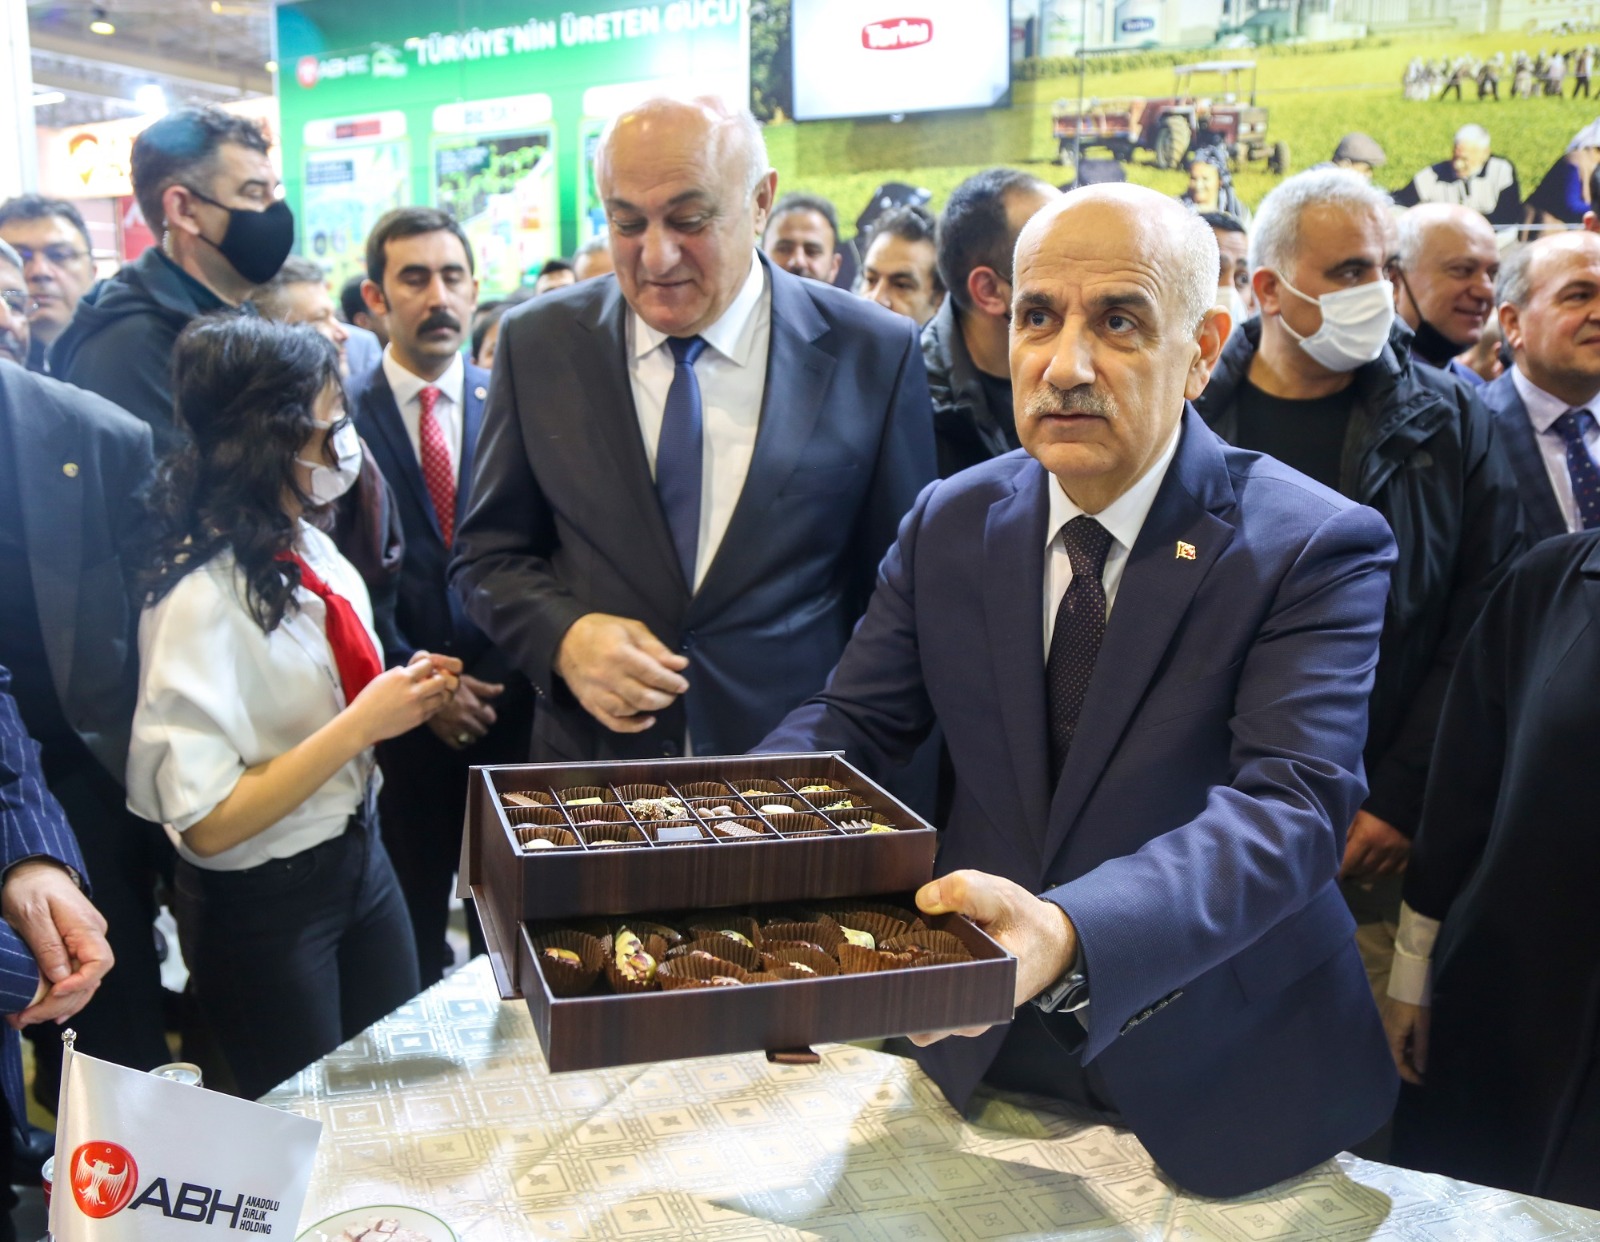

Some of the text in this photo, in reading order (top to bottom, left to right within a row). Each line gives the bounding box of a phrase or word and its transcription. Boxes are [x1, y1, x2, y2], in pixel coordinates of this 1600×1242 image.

[560, 12, 660, 47] ÜRETEN
[127, 1177, 245, 1229] ABH
[245, 1196, 280, 1212] ANADOLU
